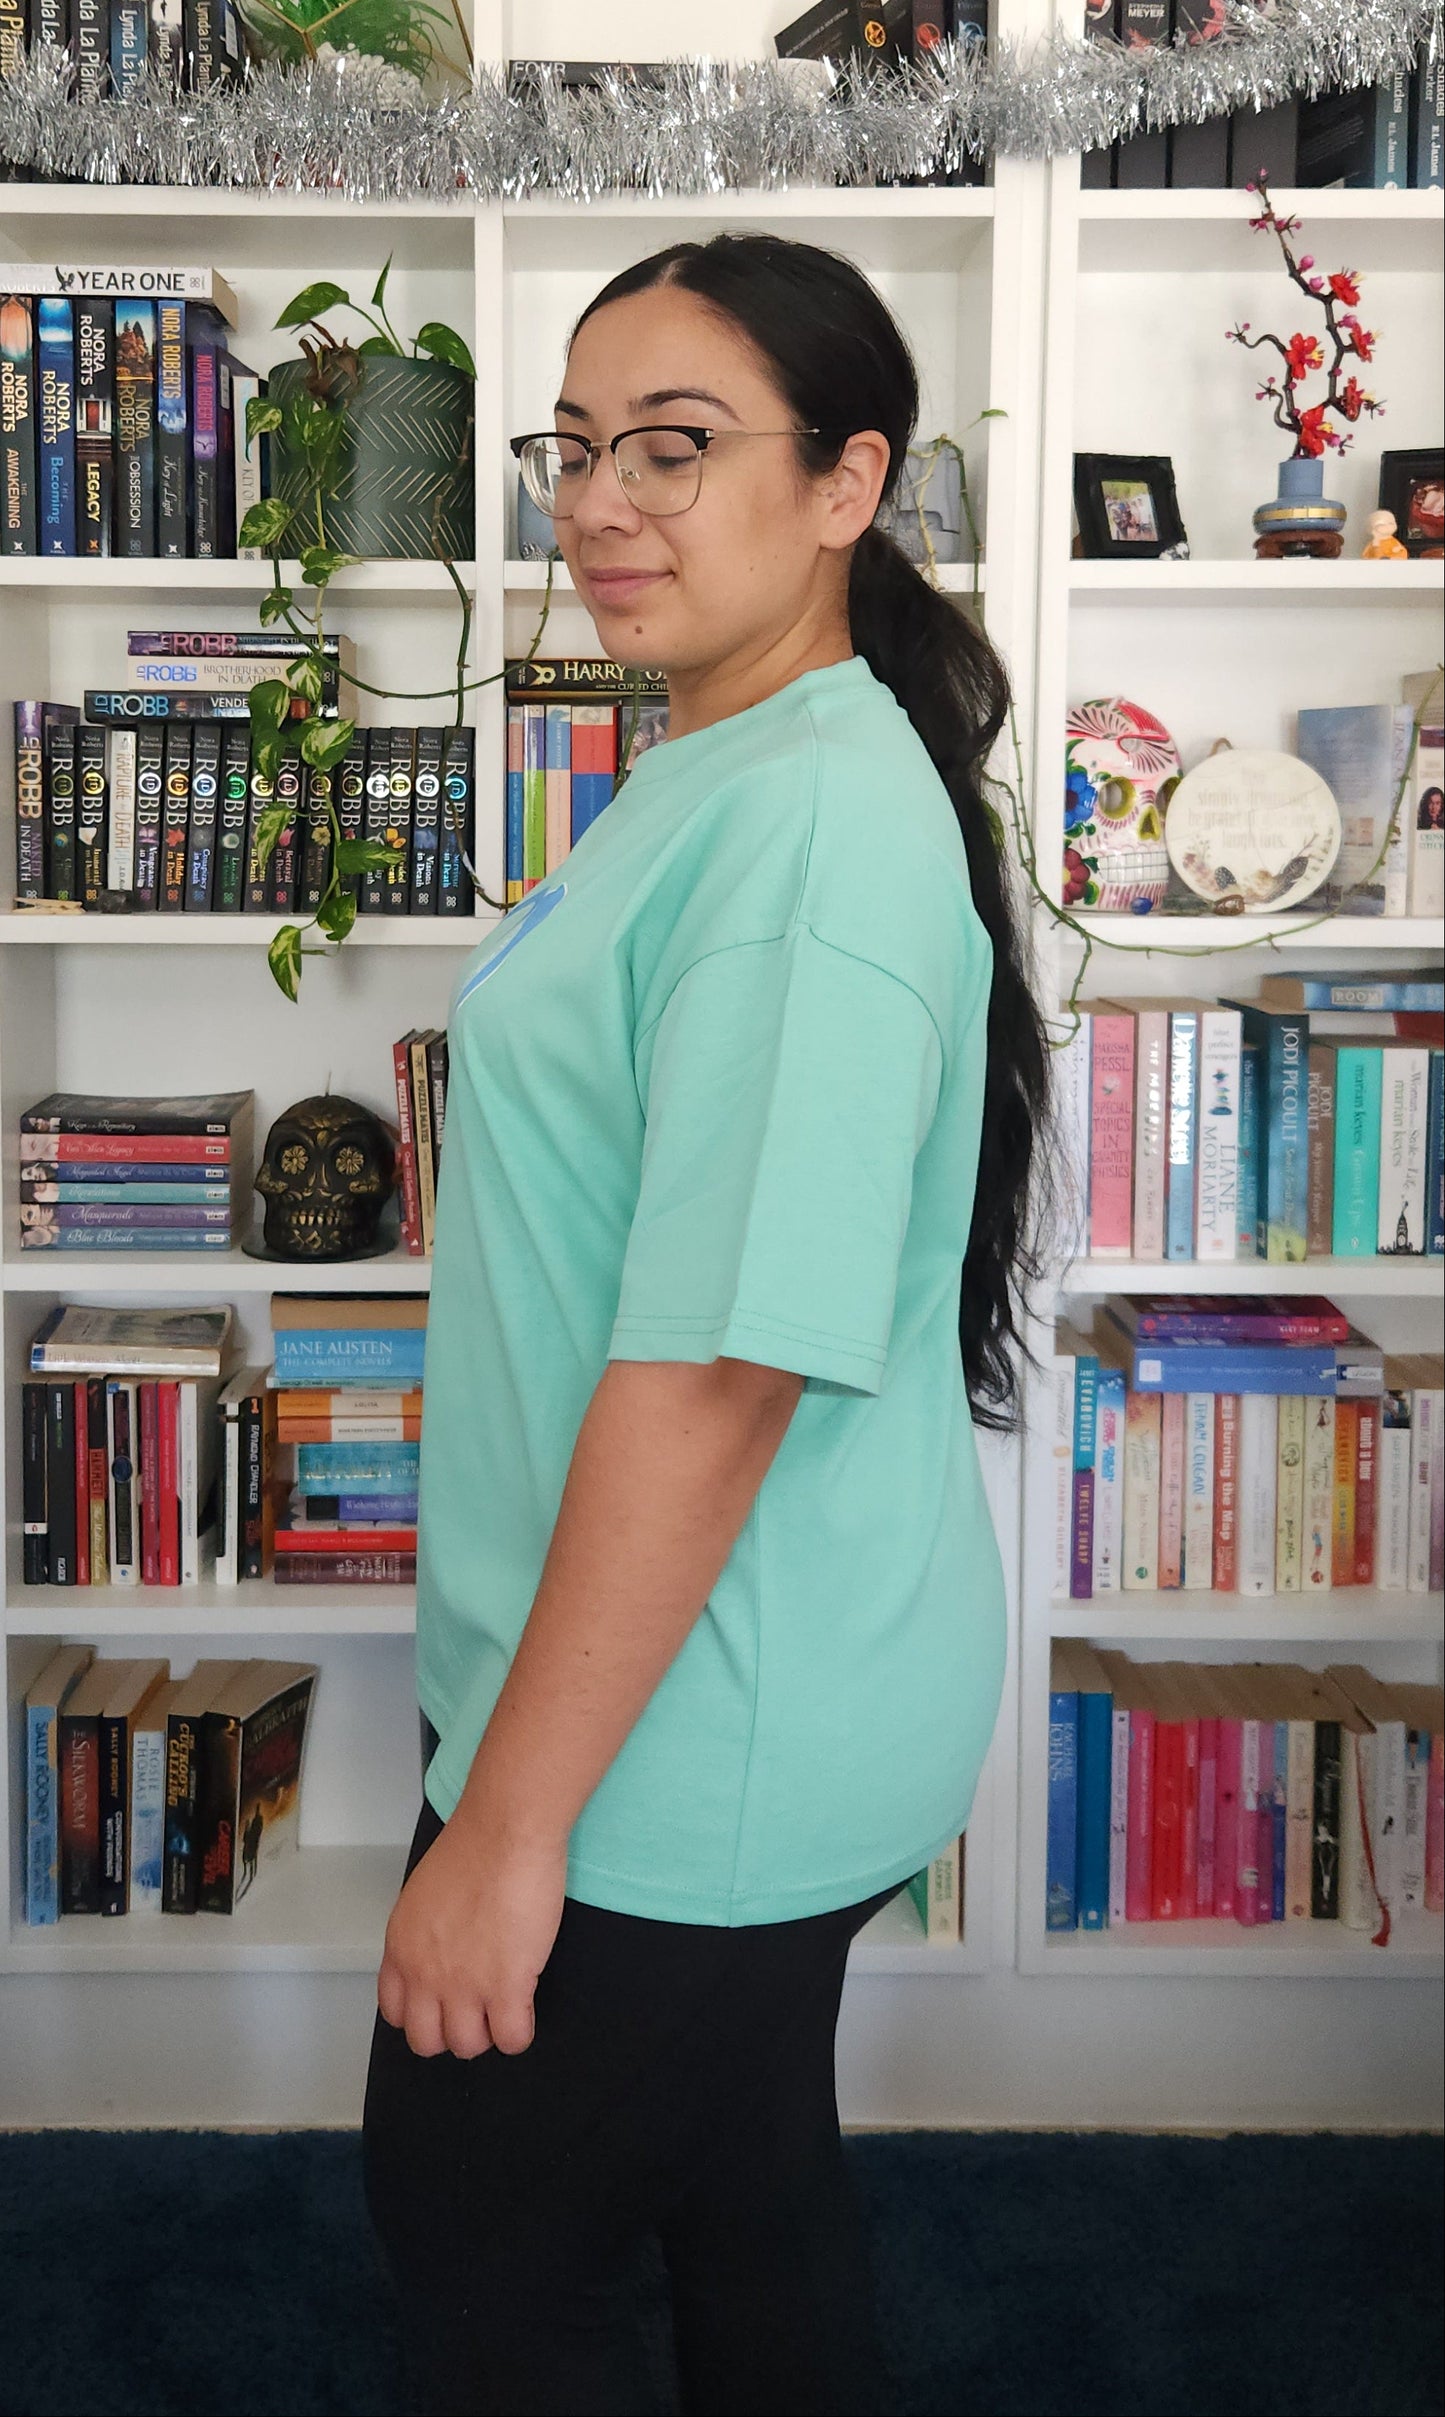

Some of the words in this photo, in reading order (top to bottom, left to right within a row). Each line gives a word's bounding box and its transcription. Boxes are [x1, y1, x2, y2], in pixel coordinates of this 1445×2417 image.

[118, 8, 138, 49] Lynda
[1127, 9, 1165, 18] MEYER
[79, 28, 98, 48] La
[197, 41, 212, 52] La
[120, 53, 138, 69] La
[76, 271, 135, 291] YEAR
[139, 273, 186, 292] ONE
[162, 307, 180, 341] NORA
[80, 315, 93, 387] ROBERTS
[92, 328, 106, 373] NORA
[197, 354, 213, 382] NORA
[162, 344, 181, 401] ROBERTS
[1, 361, 16, 433] ROBERTS
[15, 374, 28, 421] NORA
[42, 369, 57, 445] ROBERTS
[56, 381, 71, 433] NORA
[197, 386, 213, 431] ROBERTS
[119, 384, 136, 453] ROBERTS
[136, 398, 151, 440] NORA
[163, 456, 178, 481] Key
[6, 448, 21, 530] AWAKENING
[46, 456, 64, 525] Becoming
[86, 462, 100, 523] LEGACY
[129, 461, 142, 529] OBSESSION
[163, 487, 179, 519] Light
[173, 634, 238, 655] ROBB
[145, 664, 198, 682] ROBB
[203, 664, 281, 676] BROTHERHOOD
[217, 675, 229, 684] IN
[562, 661, 627, 682] HARRY
[617, 683, 650, 691] CURED
[110, 695, 170, 717] ROBB
[18, 750, 43, 819] ROBB
[51, 756, 74, 827] ROBB
[81, 755, 104, 826] ROBB
[116, 752, 134, 801] RAPTURE
[137, 755, 162, 826] ROBB
[166, 756, 191, 826] ROBB
[192, 756, 218, 826] ROBB
[223, 758, 248, 829] ROBB
[340, 758, 365, 828] ROBB
[366, 759, 390, 829] ROBB
[389, 757, 412, 828] ROBB
[415, 758, 441, 829] ROBB
[21, 825, 32, 838] IN
[114, 811, 131, 849] DEATH
[20, 839, 32, 882] DEATH
[31, 832, 42, 877] NAKED
[166, 859, 175, 886] Death
[175, 852, 185, 886] Holiday
[192, 860, 201, 885] Death
[200, 848, 212, 890] Conspiracy
[284, 849, 294, 883] Betrayal
[416, 851, 425, 860] in
[424, 854, 436, 886] Visions
[414, 862, 426, 888] Death
[442, 862, 452, 889] Death
[1334, 990, 1381, 1003] ROOM
[1093, 1056, 1131, 1072] PESSL
[1149, 1040, 1158, 1066] THE
[1171, 1018, 1197, 1107] Danielle
[1280, 1026, 1300, 1064] JODI
[397, 1078, 409, 1112] PUZZLE
[417, 1079, 428, 1113] PUZZLE
[434, 1079, 444, 1113] PUZZLE
[1307, 1071, 1321, 1132] PICOULT
[1320, 1085, 1333, 1117] JODI
[1354, 1064, 1366, 1108] marian
[1392, 1079, 1406, 1127] marian
[1409, 1071, 1421, 1113] Woman
[1092, 1117, 1131, 1133] TOPICS
[1093, 1100, 1131, 1115] SPECIAL
[1281, 1069, 1299, 1145] PICOULT
[400, 1113, 412, 1145] MATES
[418, 1114, 430, 1144] MATES
[436, 1114, 445, 1145] MATES
[1102, 1134, 1119, 1149] IN
[1168, 1108, 1191, 1166] Steel
[1352, 1110, 1367, 1145] keyes
[1390, 1130, 1407, 1168] keyes
[1092, 1165, 1130, 1179] PHYSICS
[1201, 1125, 1218, 1233] MORIARTY
[1219, 1143, 1236, 1215] LIANE
[71, 1205, 135, 1225] Masquerade
[66, 1227, 95, 1243] Blue
[97, 1227, 135, 1243] Bloods
[280, 1340, 324, 1355] JANE
[327, 1340, 393, 1355] AUSTEN
[1079, 1379, 1094, 1452] EVANOVICH
[1194, 1402, 1208, 1440] JENNY
[250, 1424, 260, 1462] RAYMOND
[1219, 1420, 1234, 1477] Burning
[249, 1464, 260, 1504] CHANDLER
[1191, 1444, 1207, 1496] COLGAN
[1078, 1484, 1090, 1526] TWELVE
[1221, 1482, 1234, 1506] the
[1219, 1510, 1234, 1540] Map
[1077, 1530, 1089, 1566] SHARP
[35, 1721, 49, 1760] SALLY
[110, 1727, 118, 1756] SALLY
[1049, 1722, 1064, 1782] JOHNS
[71, 1739, 90, 1832] SILKWORM
[110, 1758, 118, 1799] ROONEY
[135, 1739, 149, 1800] THOMAS
[148, 1748, 160, 1791] ROSIE
[168, 1739, 181, 1807] CALLING
